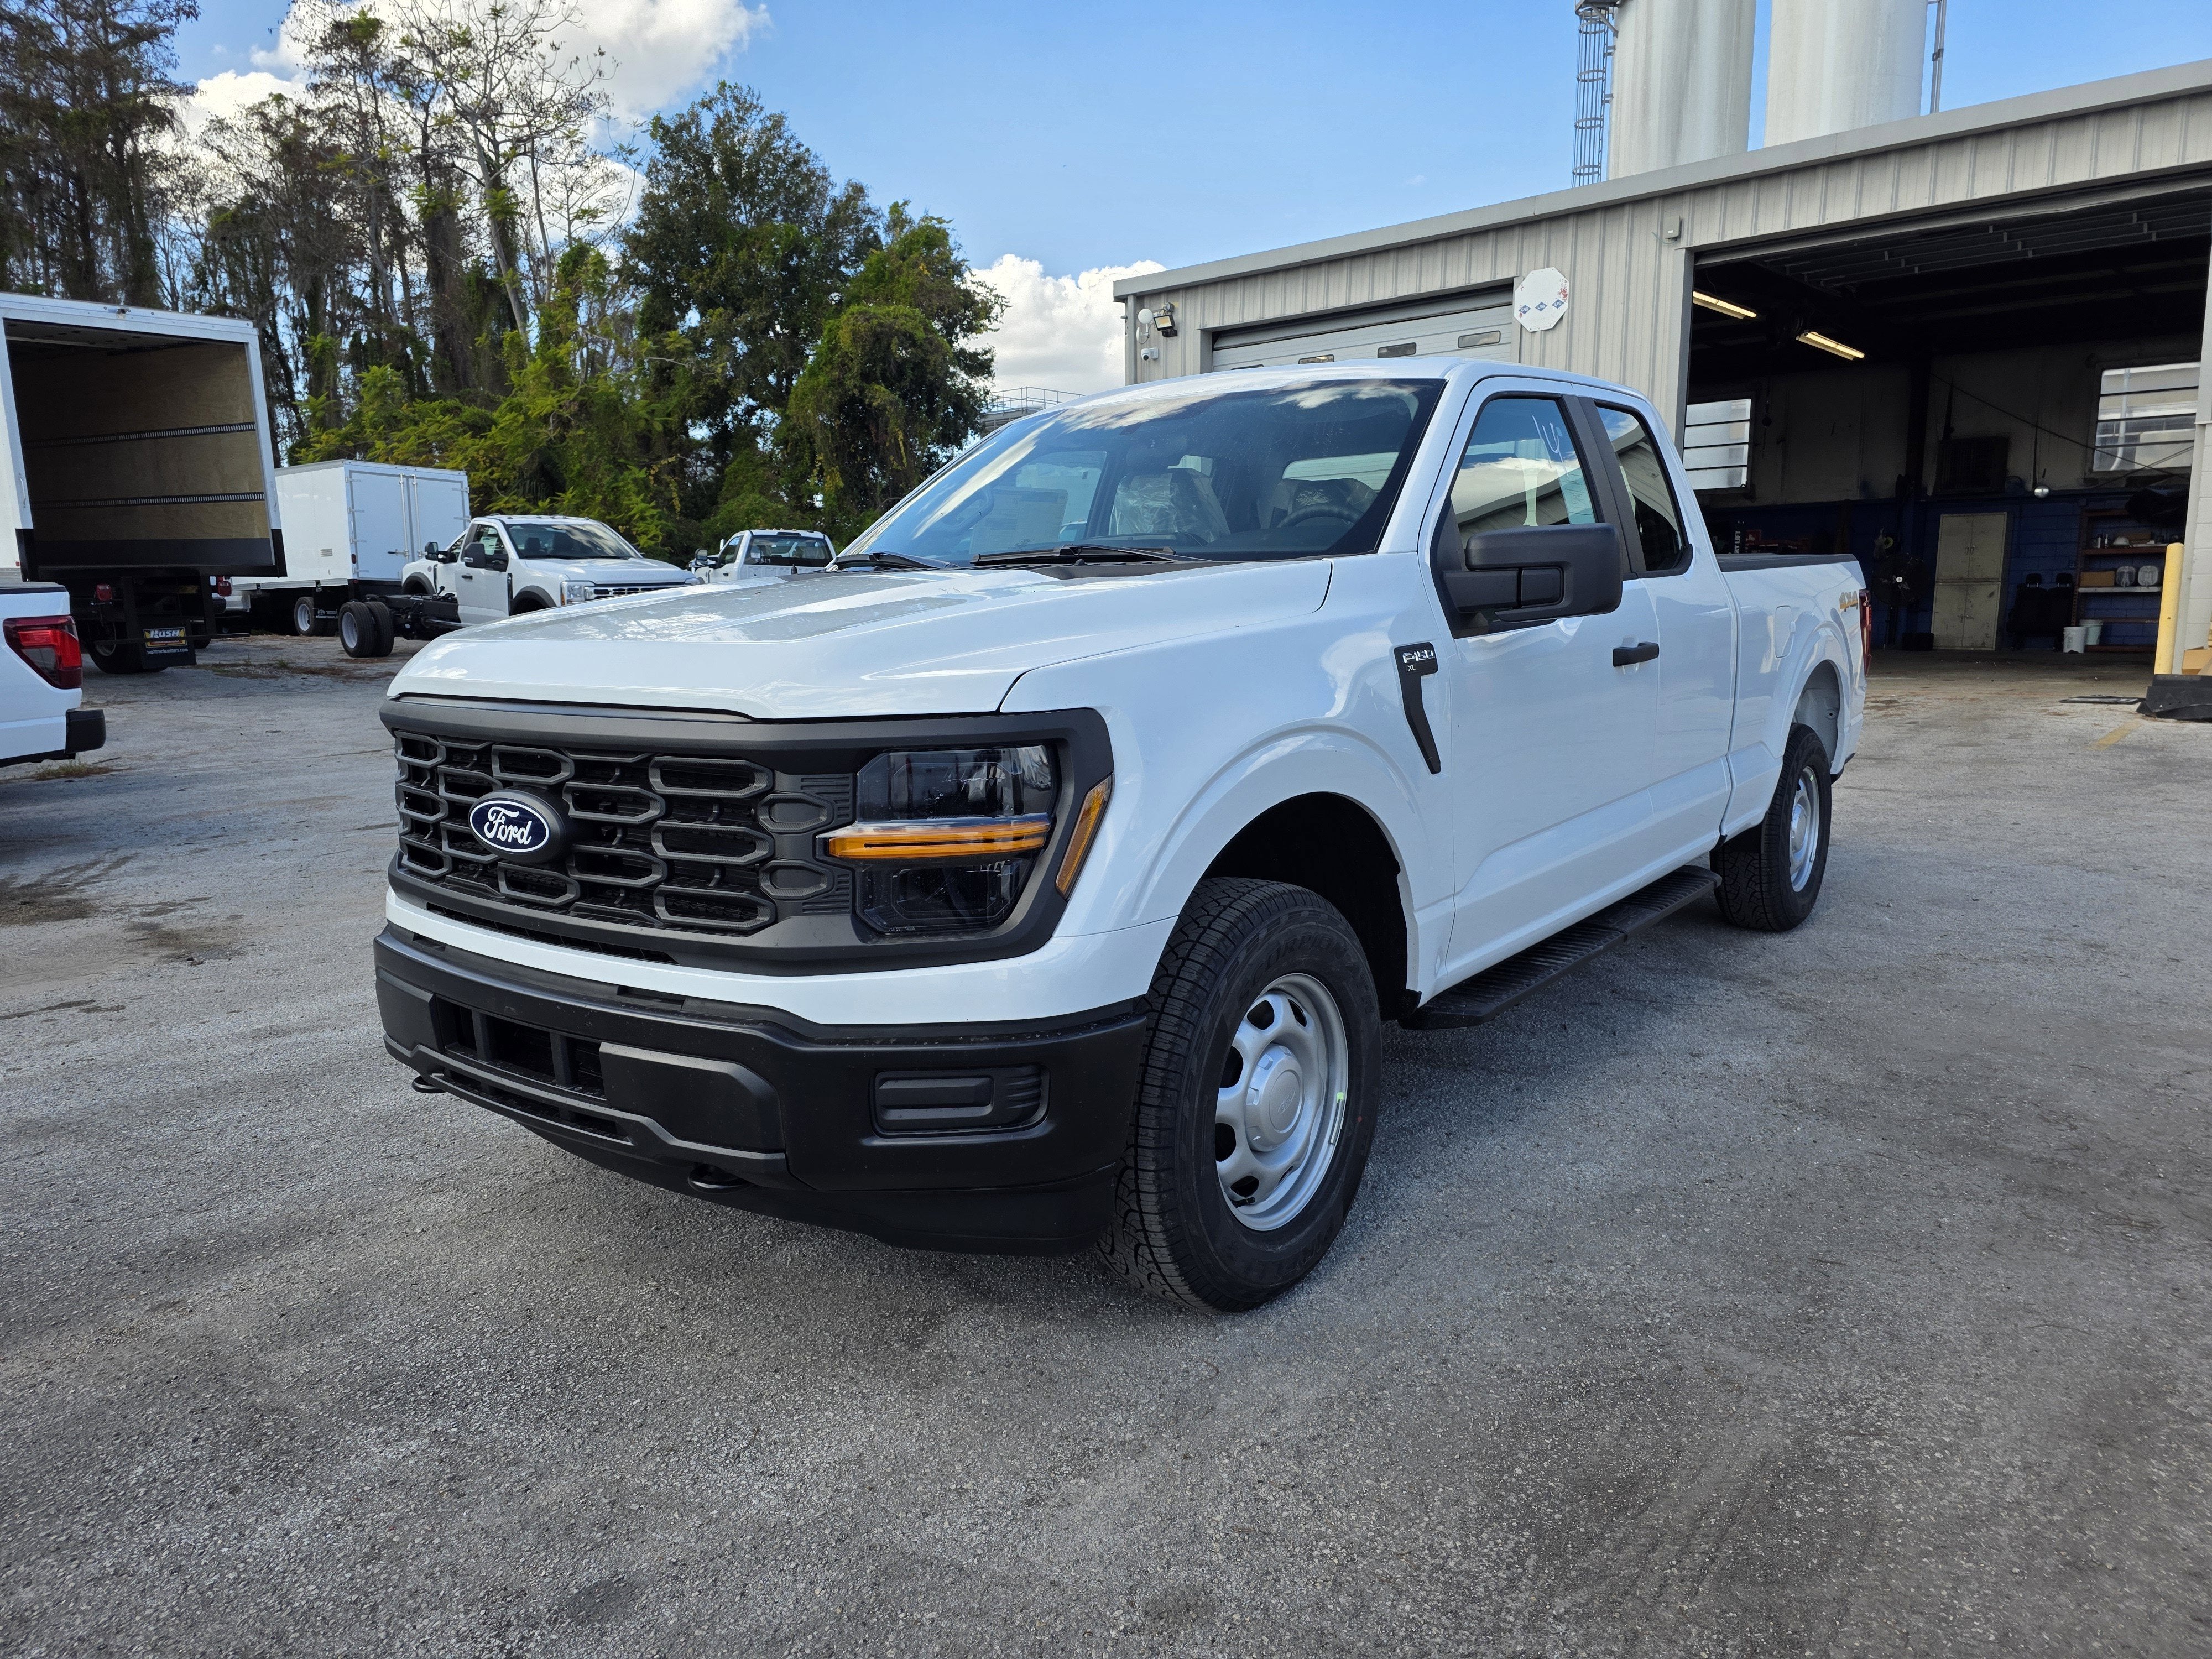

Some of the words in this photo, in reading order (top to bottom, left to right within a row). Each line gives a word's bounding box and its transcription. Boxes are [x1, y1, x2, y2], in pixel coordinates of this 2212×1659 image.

[150, 630, 180, 639] RUSH
[1402, 649, 1436, 664] F-150
[484, 806, 532, 844] Ford
